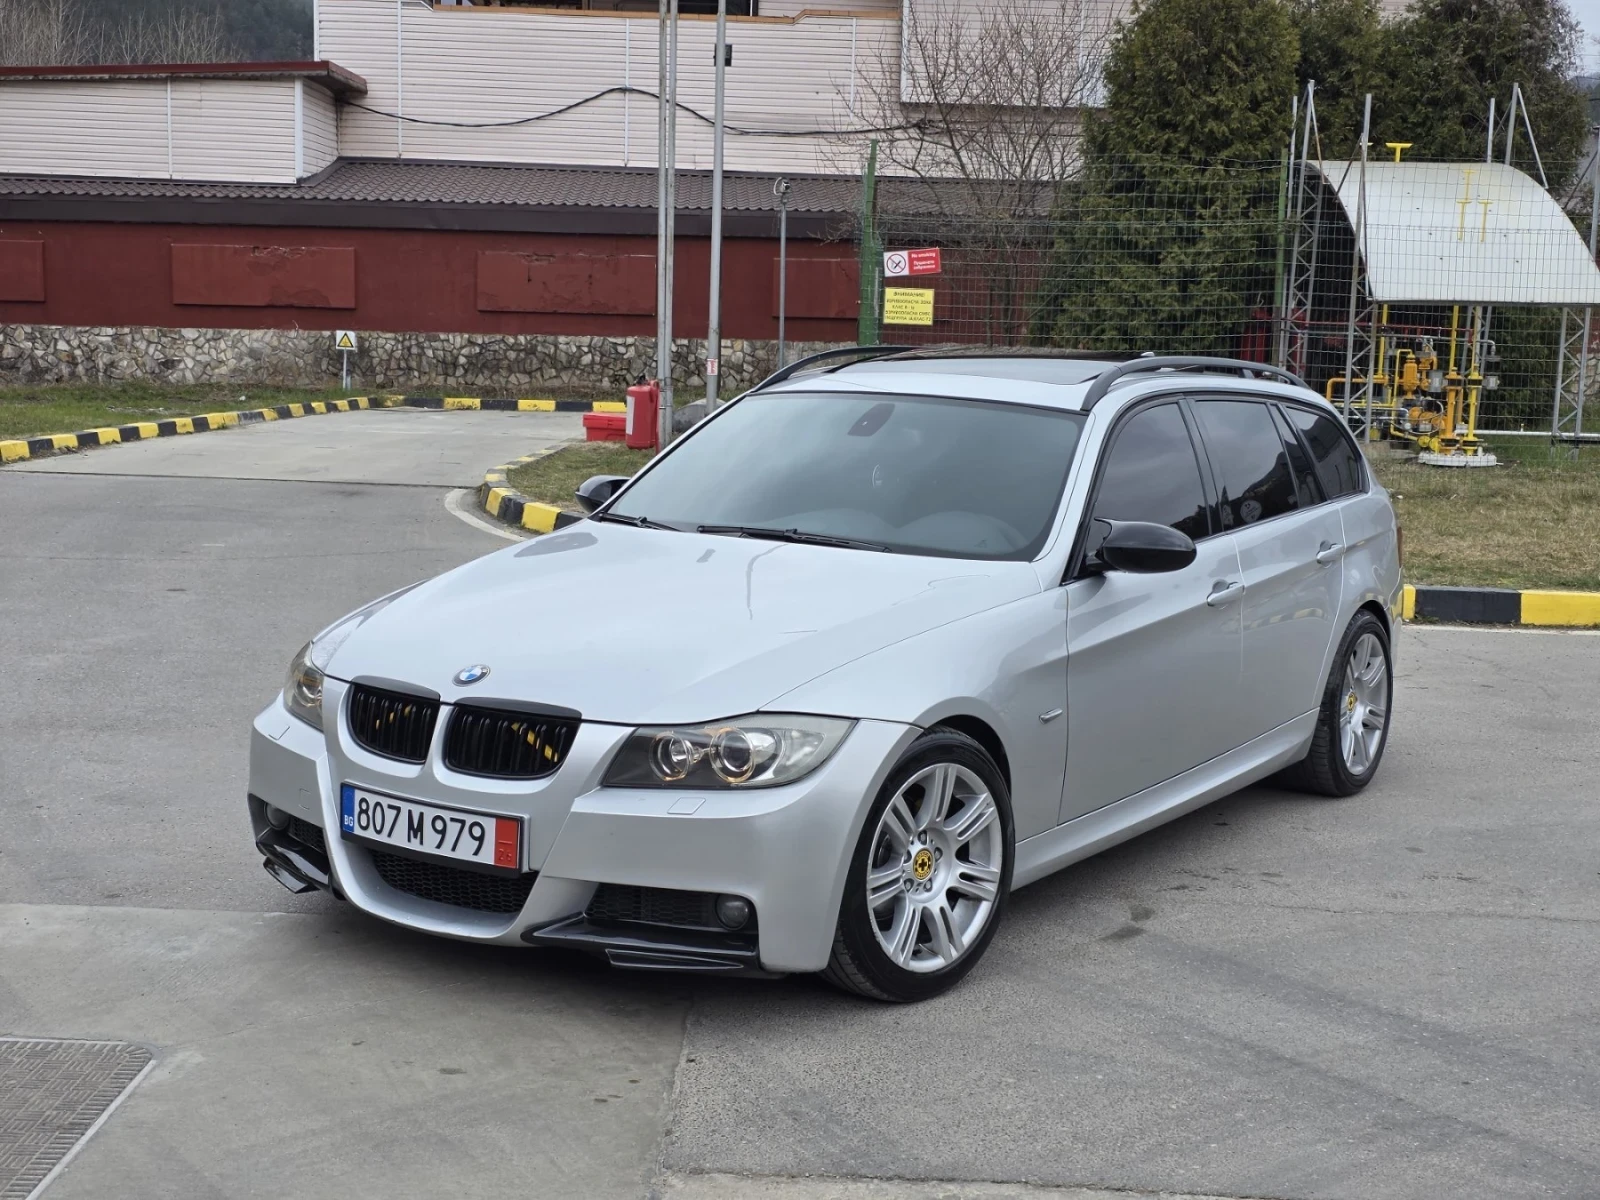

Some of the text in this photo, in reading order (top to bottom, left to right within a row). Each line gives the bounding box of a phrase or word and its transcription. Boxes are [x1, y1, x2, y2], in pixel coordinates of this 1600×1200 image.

[344, 814, 354, 827] BG
[357, 797, 402, 838] 807
[430, 814, 486, 857] 979
